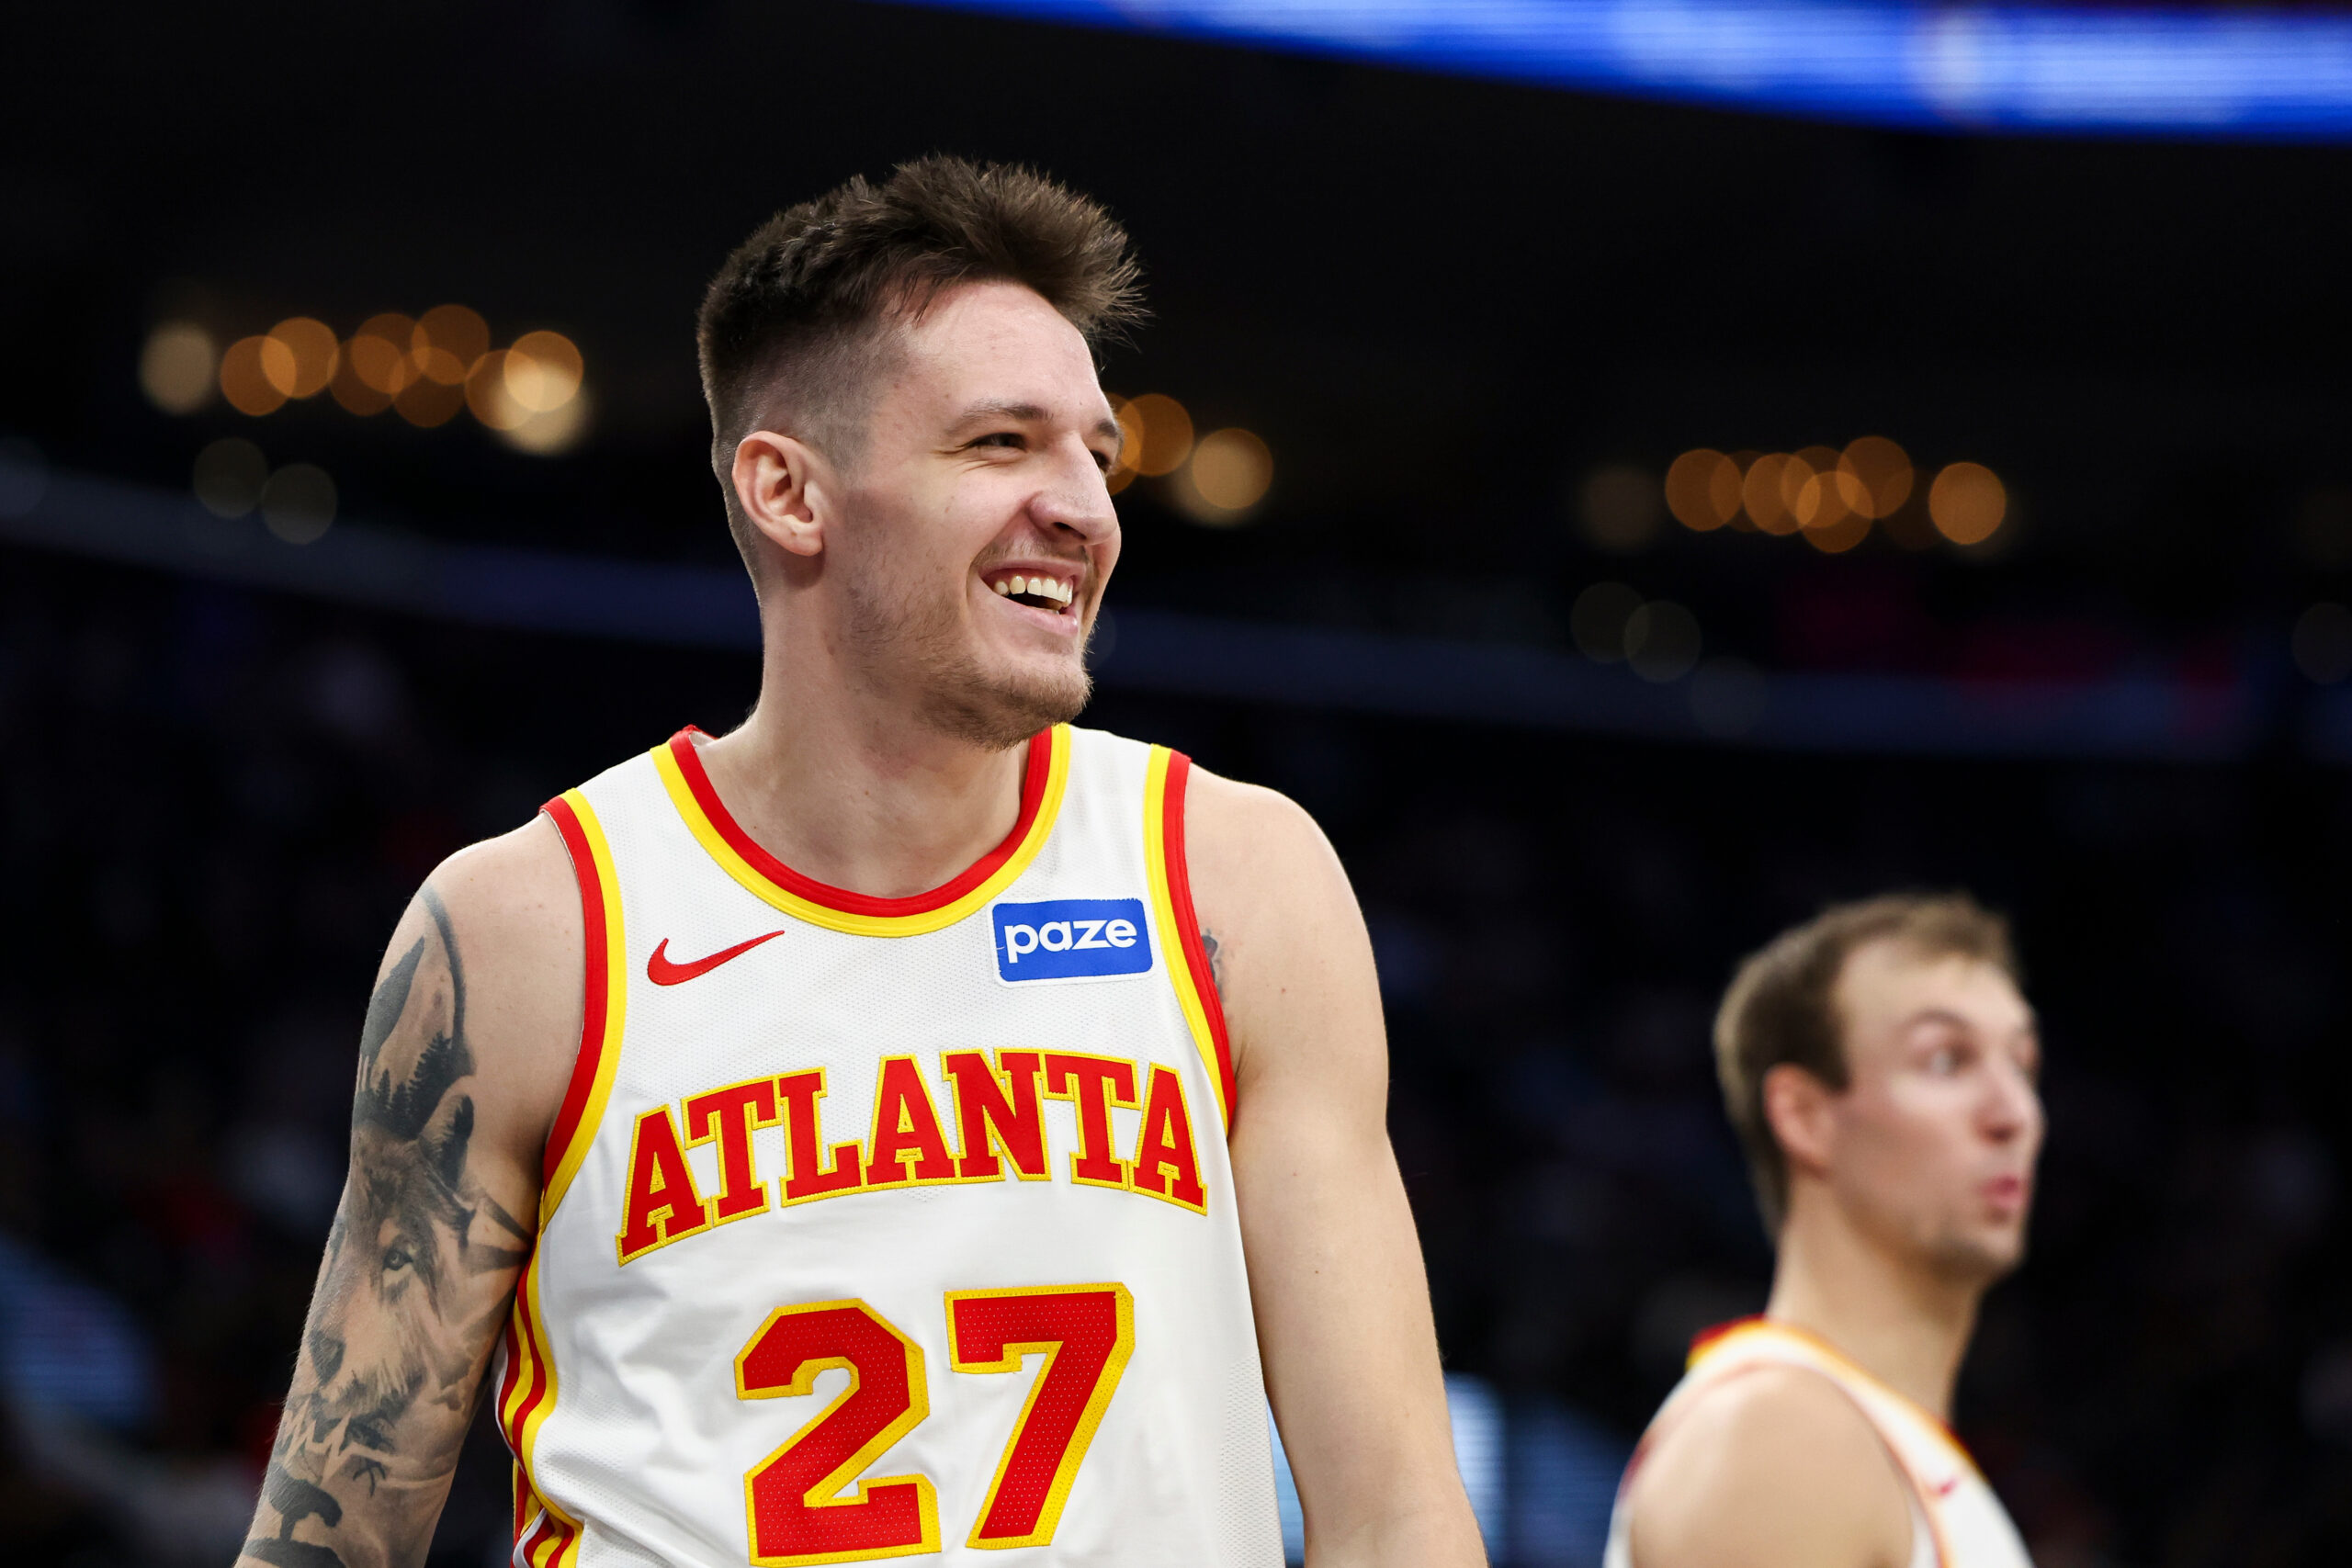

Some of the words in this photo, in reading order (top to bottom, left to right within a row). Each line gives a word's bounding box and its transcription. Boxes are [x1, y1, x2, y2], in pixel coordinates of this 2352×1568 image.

[1004, 919, 1137, 964] paze
[615, 1047, 1208, 1267] ATLANTA
[733, 1281, 1136, 1568] 27
